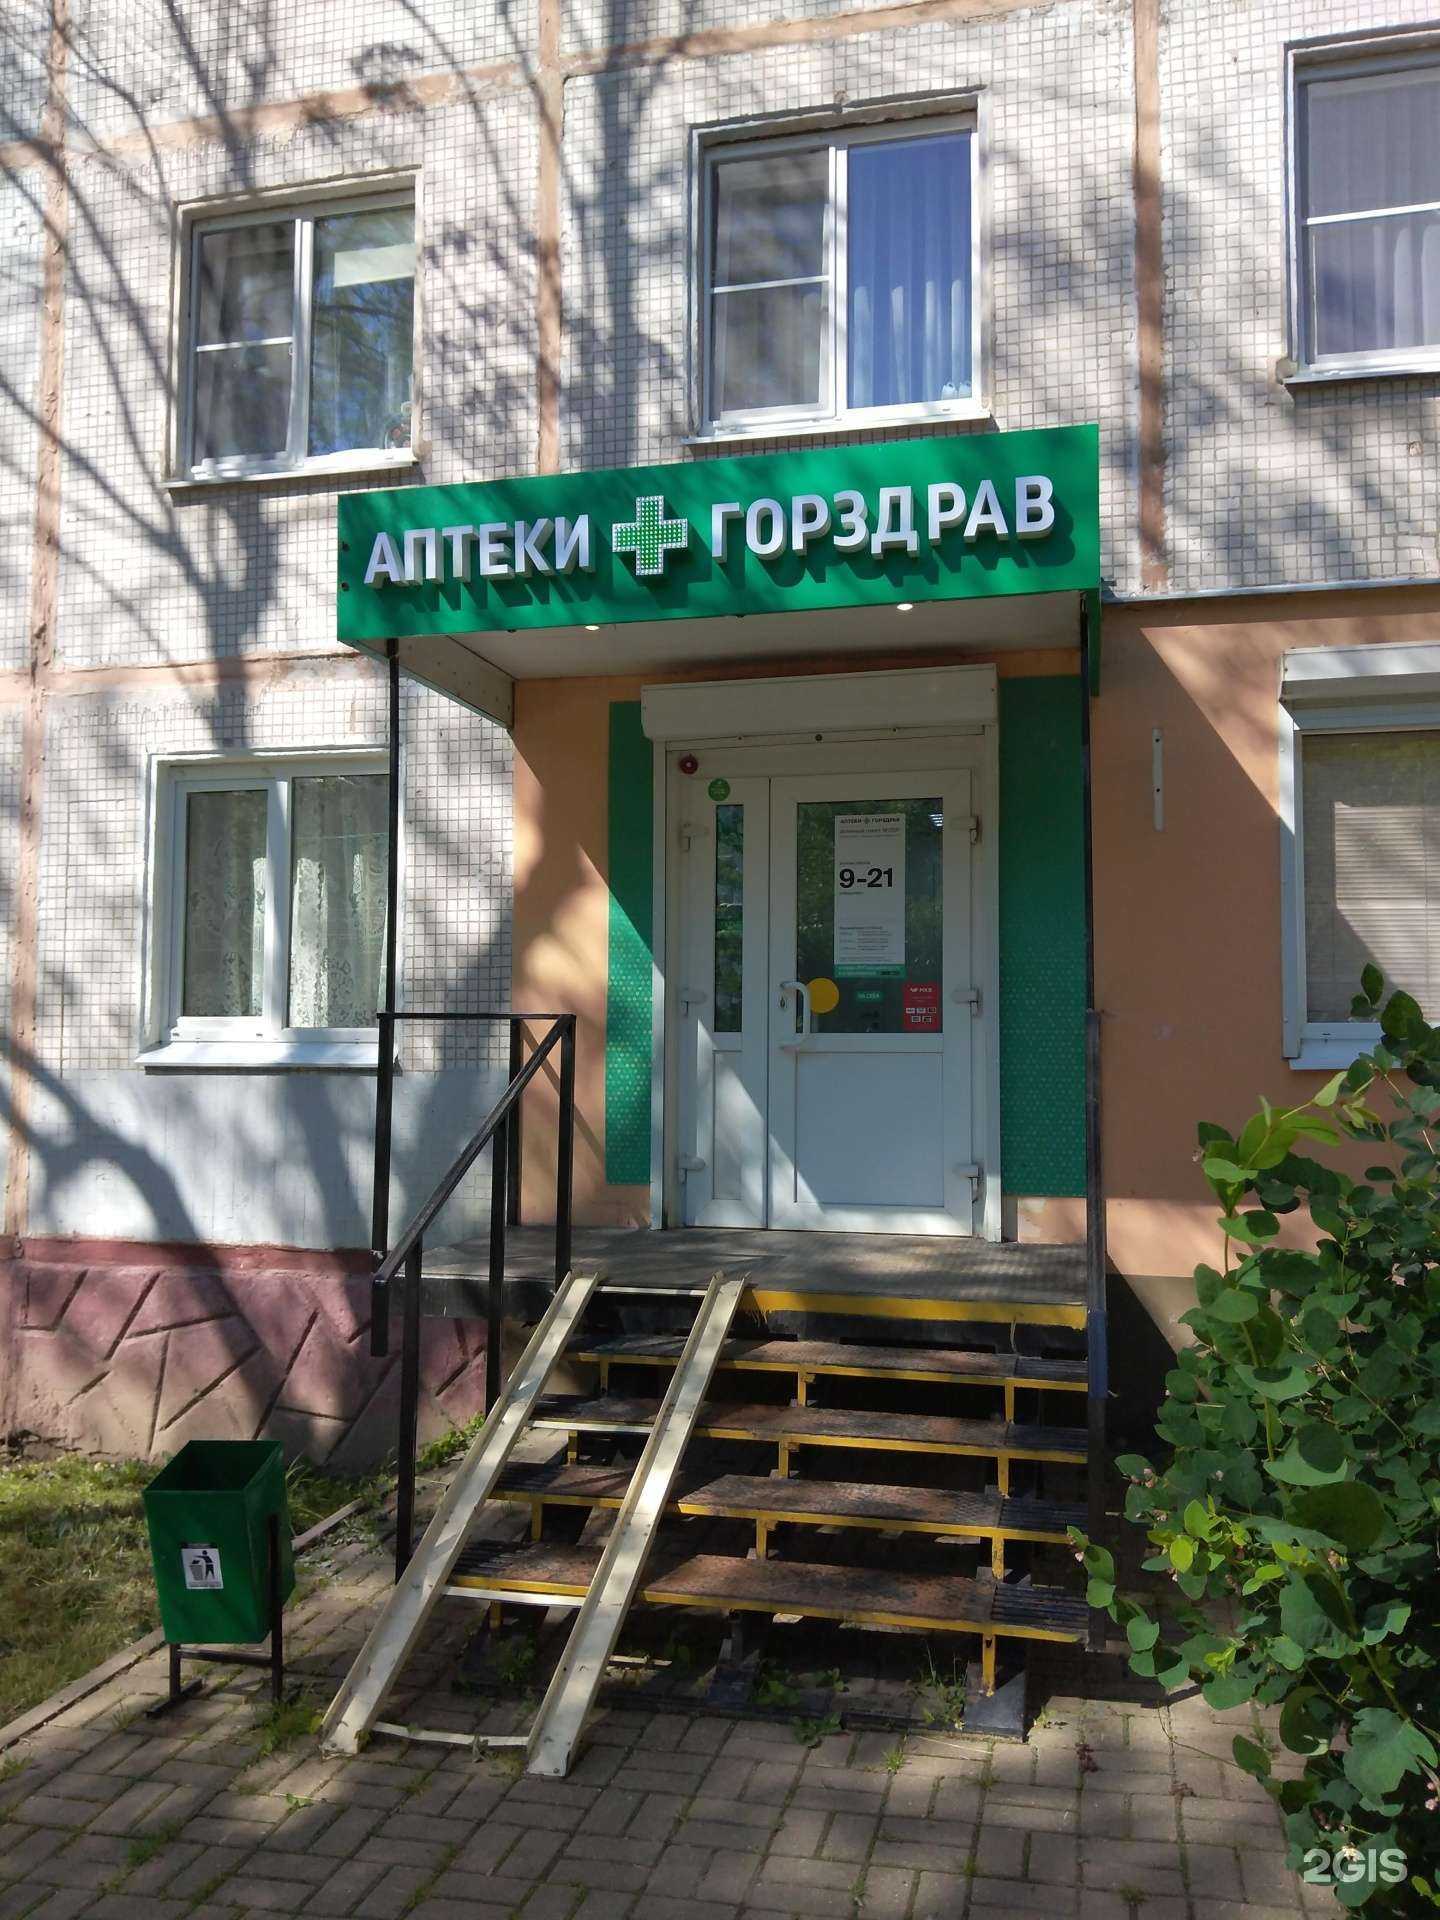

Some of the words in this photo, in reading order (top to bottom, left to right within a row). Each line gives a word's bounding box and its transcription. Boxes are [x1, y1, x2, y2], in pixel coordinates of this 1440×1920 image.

[363, 513, 596, 588] АПТЕКИ
[710, 474, 1057, 564] ГОРЗДРАВ
[839, 867, 893, 889] 9-21
